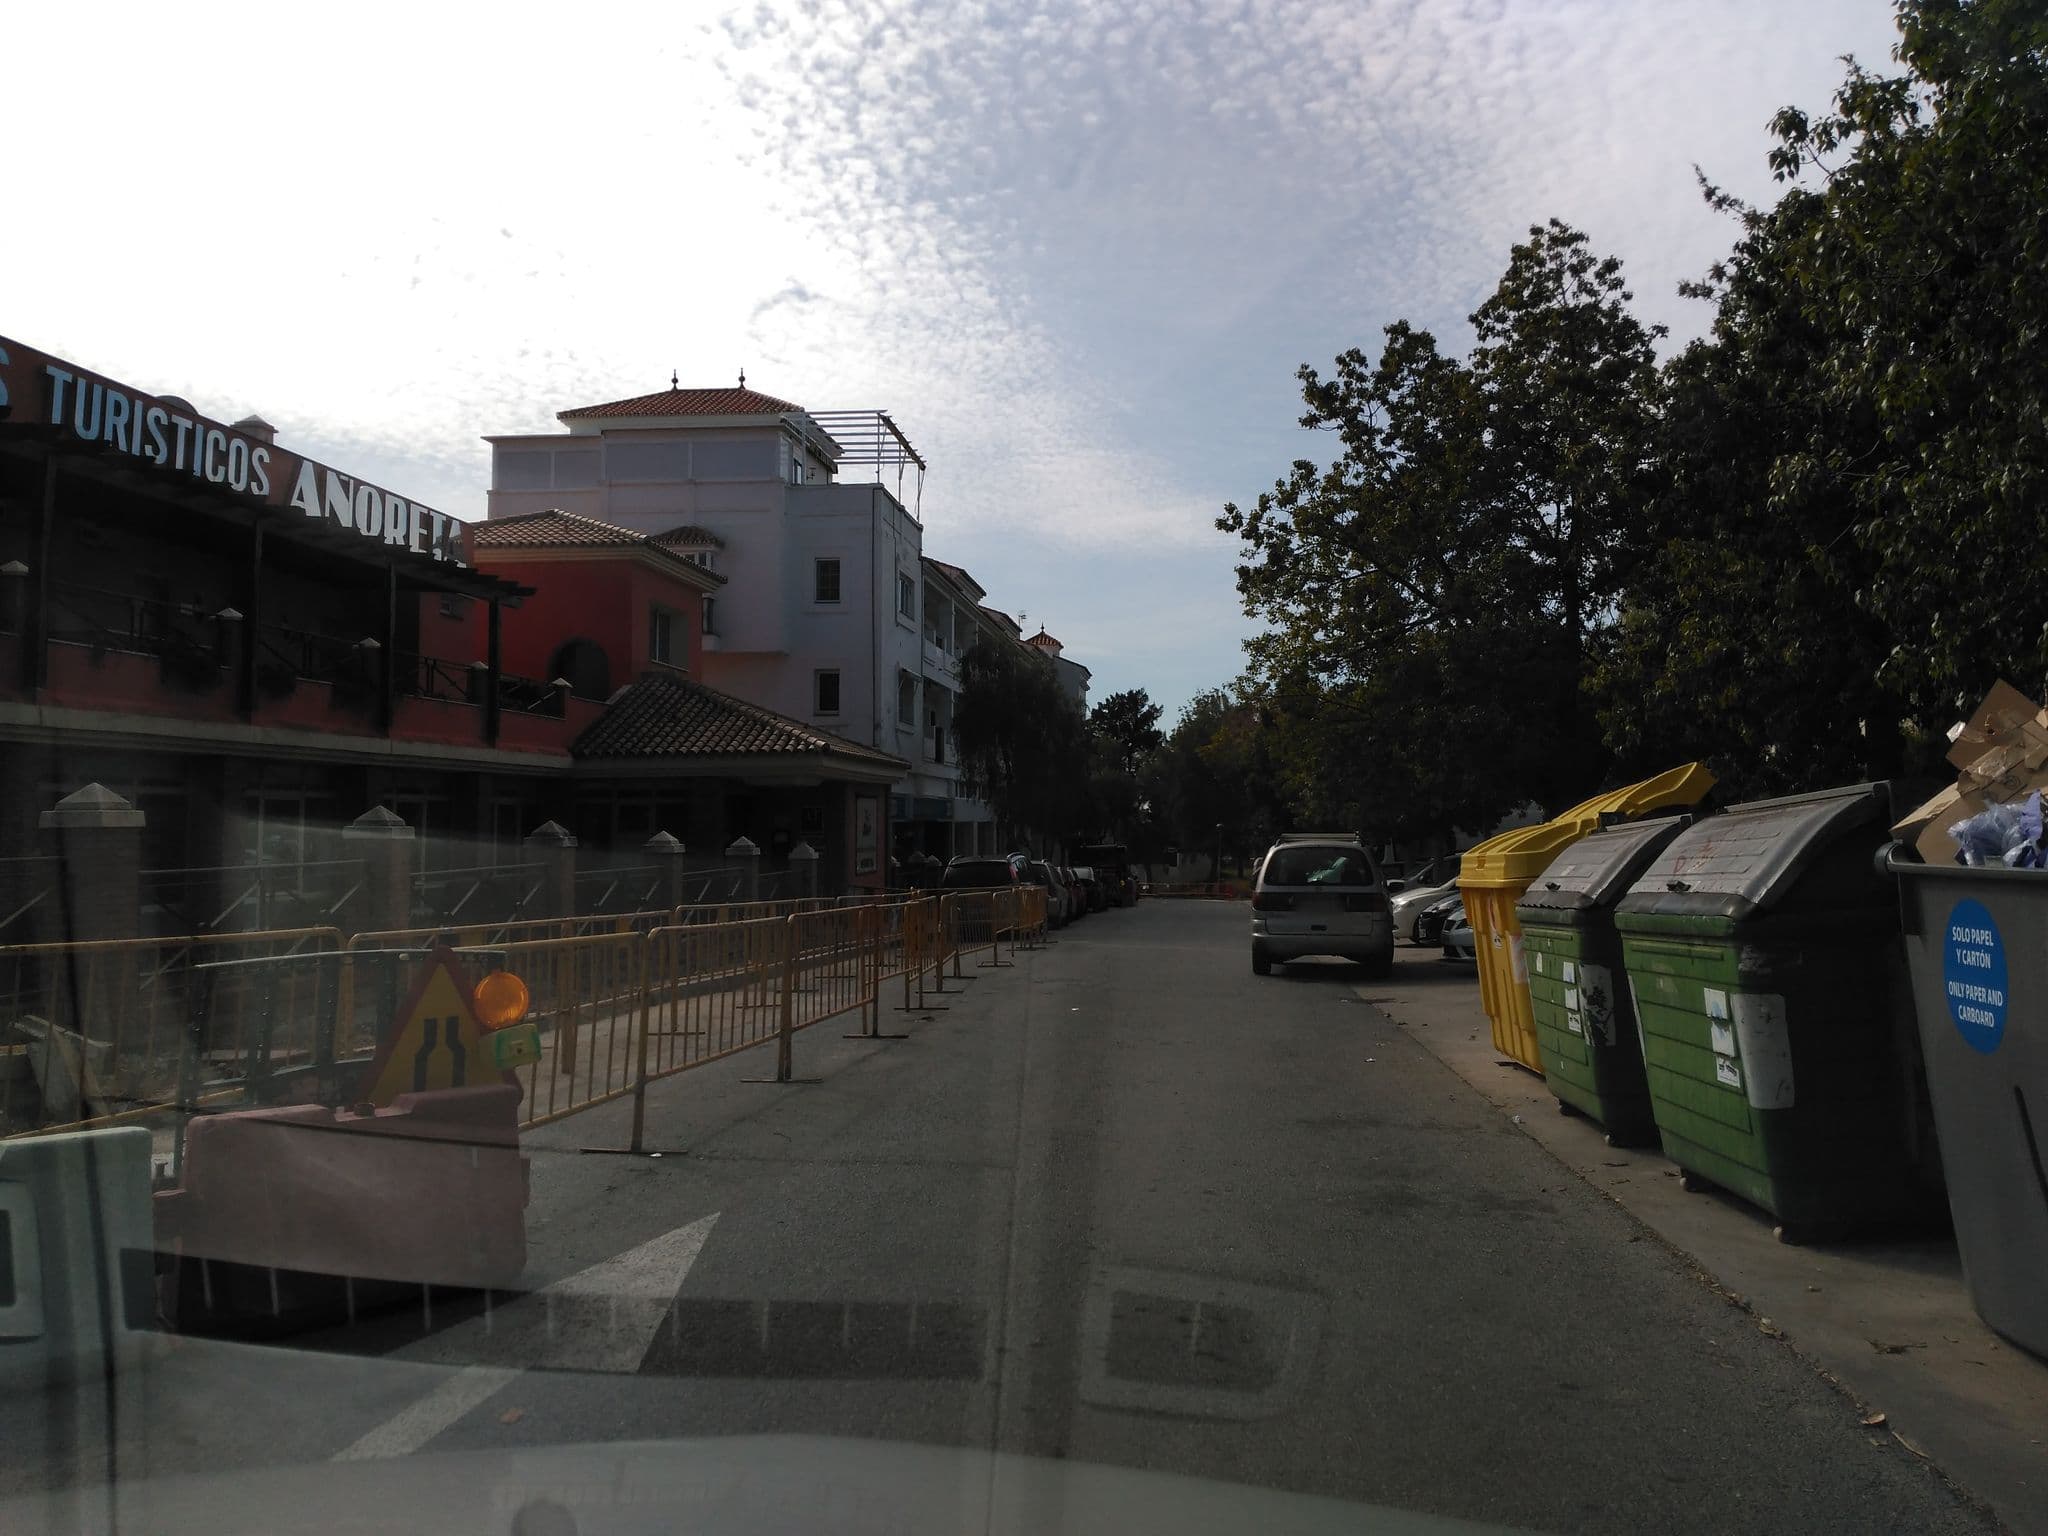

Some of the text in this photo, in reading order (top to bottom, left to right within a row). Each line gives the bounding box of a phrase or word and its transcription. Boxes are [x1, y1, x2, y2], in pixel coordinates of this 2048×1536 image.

[46, 364, 270, 495] TURISTICOS
[1952, 926, 1994, 946] SOLO PAPEL
[1956, 948, 1991, 969] Y CARTÓN
[1948, 980, 2003, 1007] ONLY PAPER AND
[1958, 1004, 1995, 1028] CARBOARD
